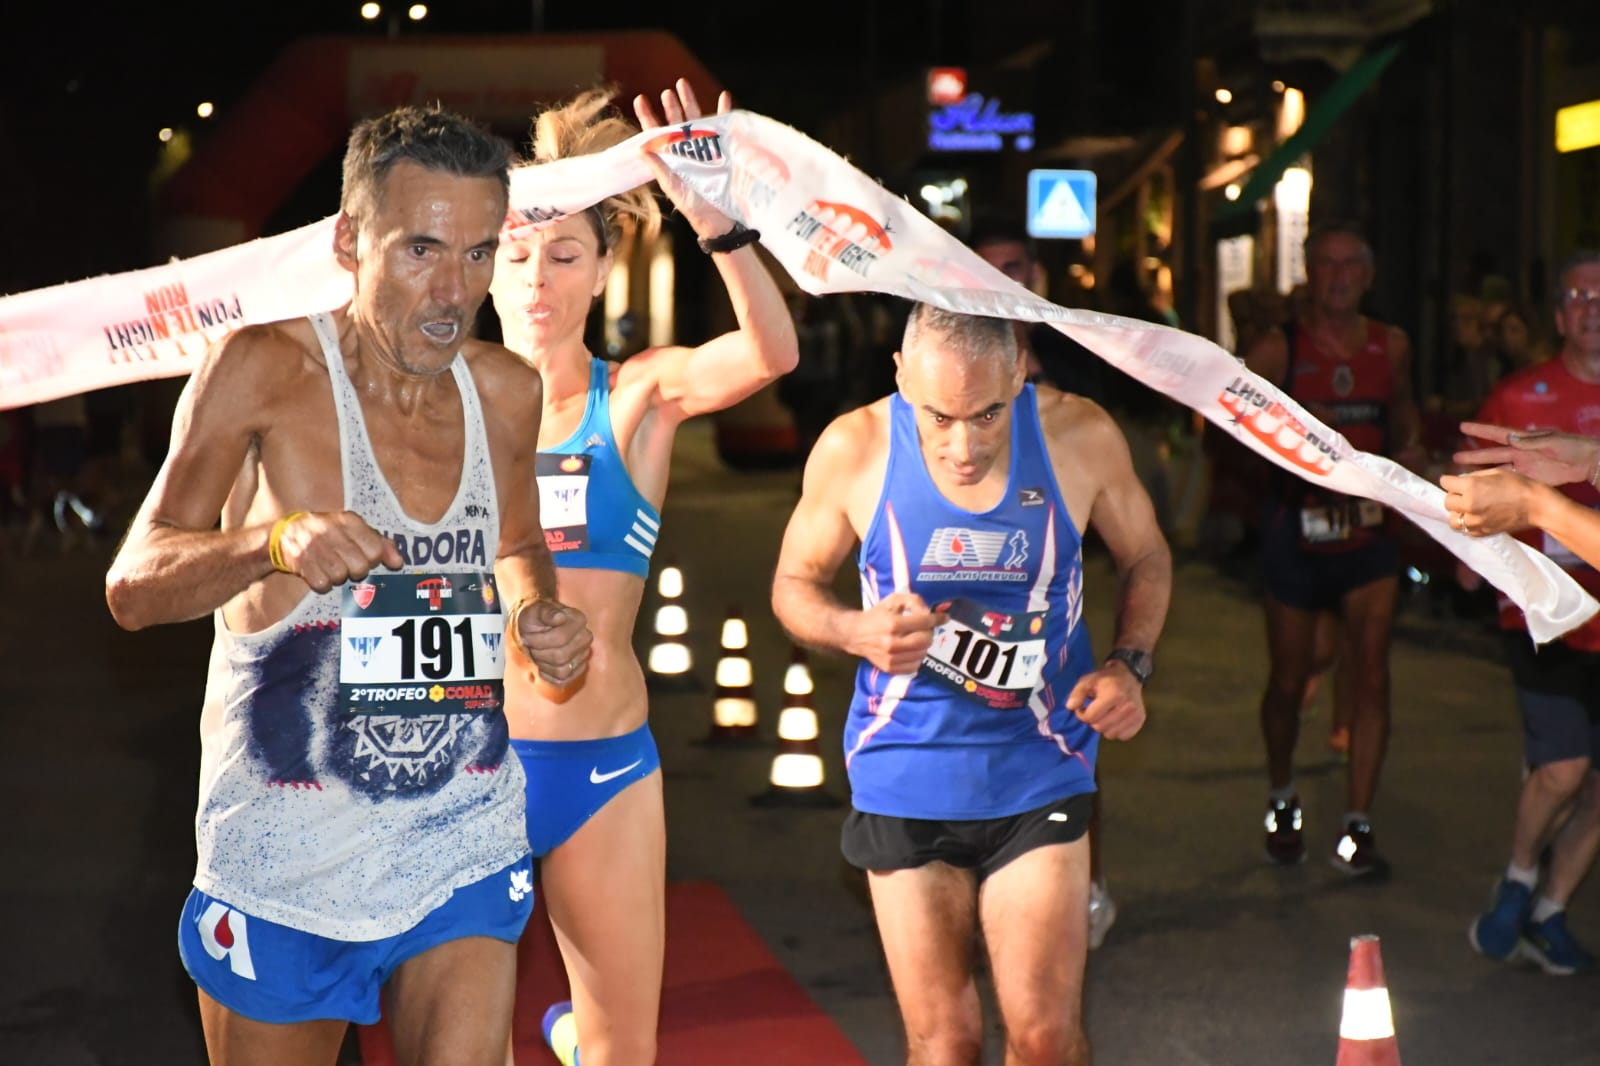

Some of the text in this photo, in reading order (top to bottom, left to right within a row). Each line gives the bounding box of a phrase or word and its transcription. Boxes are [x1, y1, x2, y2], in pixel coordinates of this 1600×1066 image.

[384, 529, 486, 566] ADORA
[955, 571, 979, 580] AVIS
[980, 572, 1028, 581] PERUGIA
[392, 617, 475, 680] 191
[950, 630, 1018, 686] 101
[445, 684, 493, 699] CONAD
